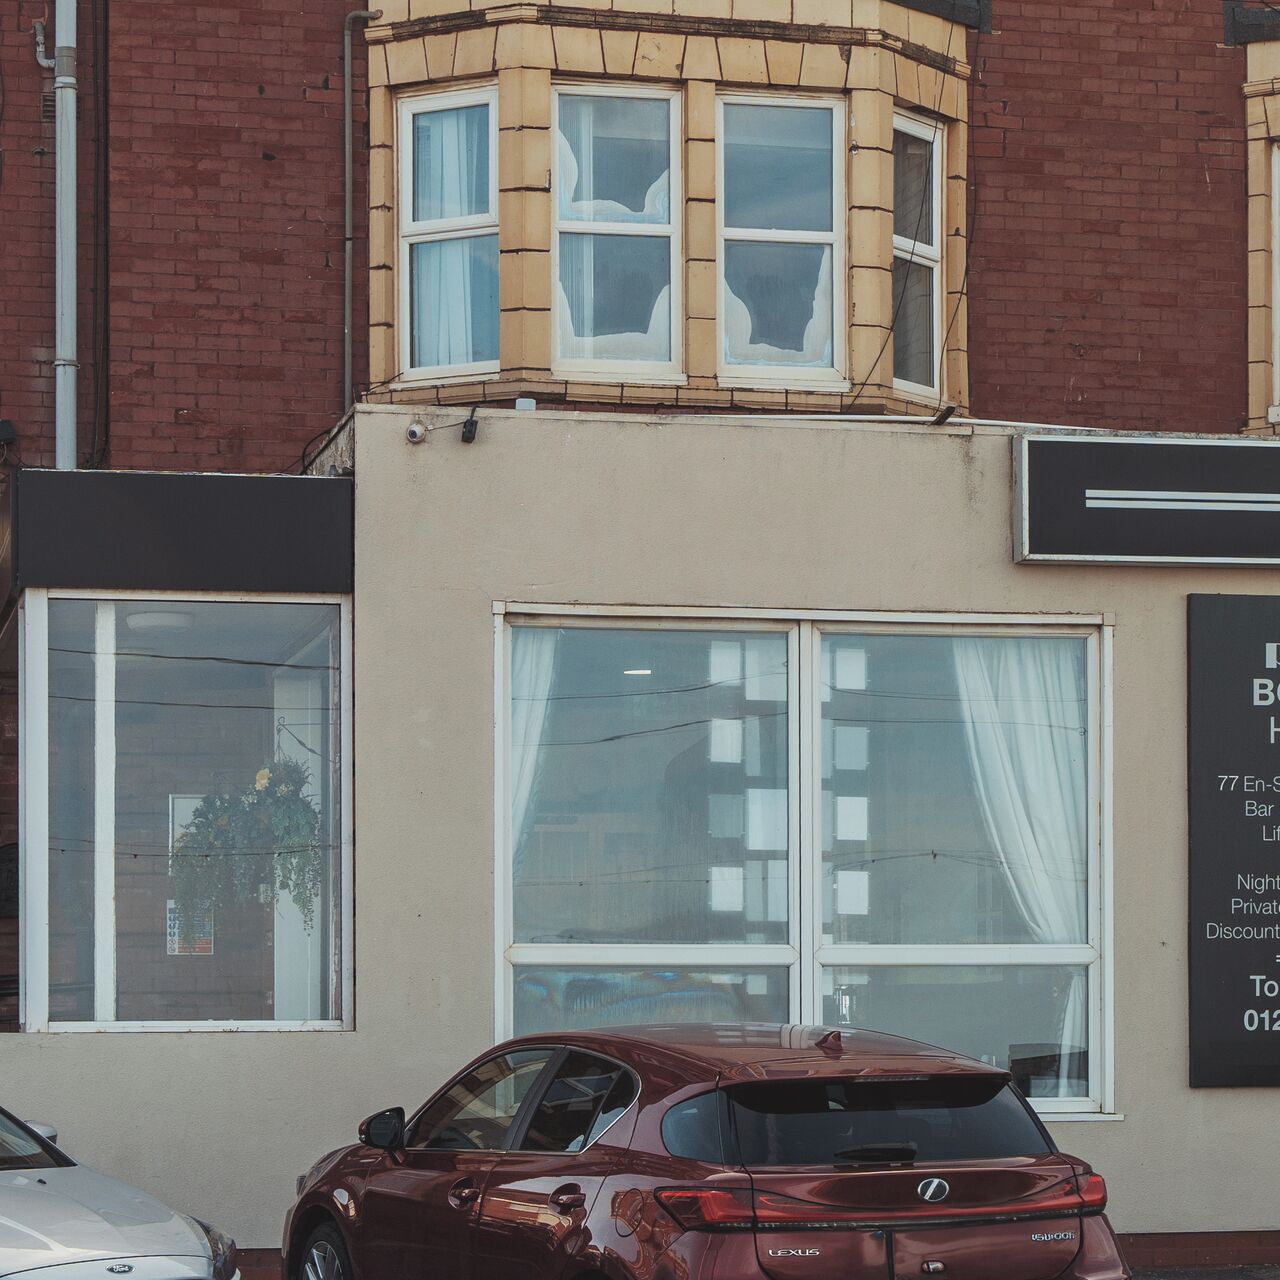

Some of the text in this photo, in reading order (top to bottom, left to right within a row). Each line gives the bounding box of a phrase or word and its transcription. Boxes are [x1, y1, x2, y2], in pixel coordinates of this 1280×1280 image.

[1217, 775, 1240, 792] 77
[1244, 800, 1275, 817] Bar
[1206, 922, 1280, 940] Discount
[1249, 974, 1280, 998] To
[768, 1248, 820, 1257] LEXUS
